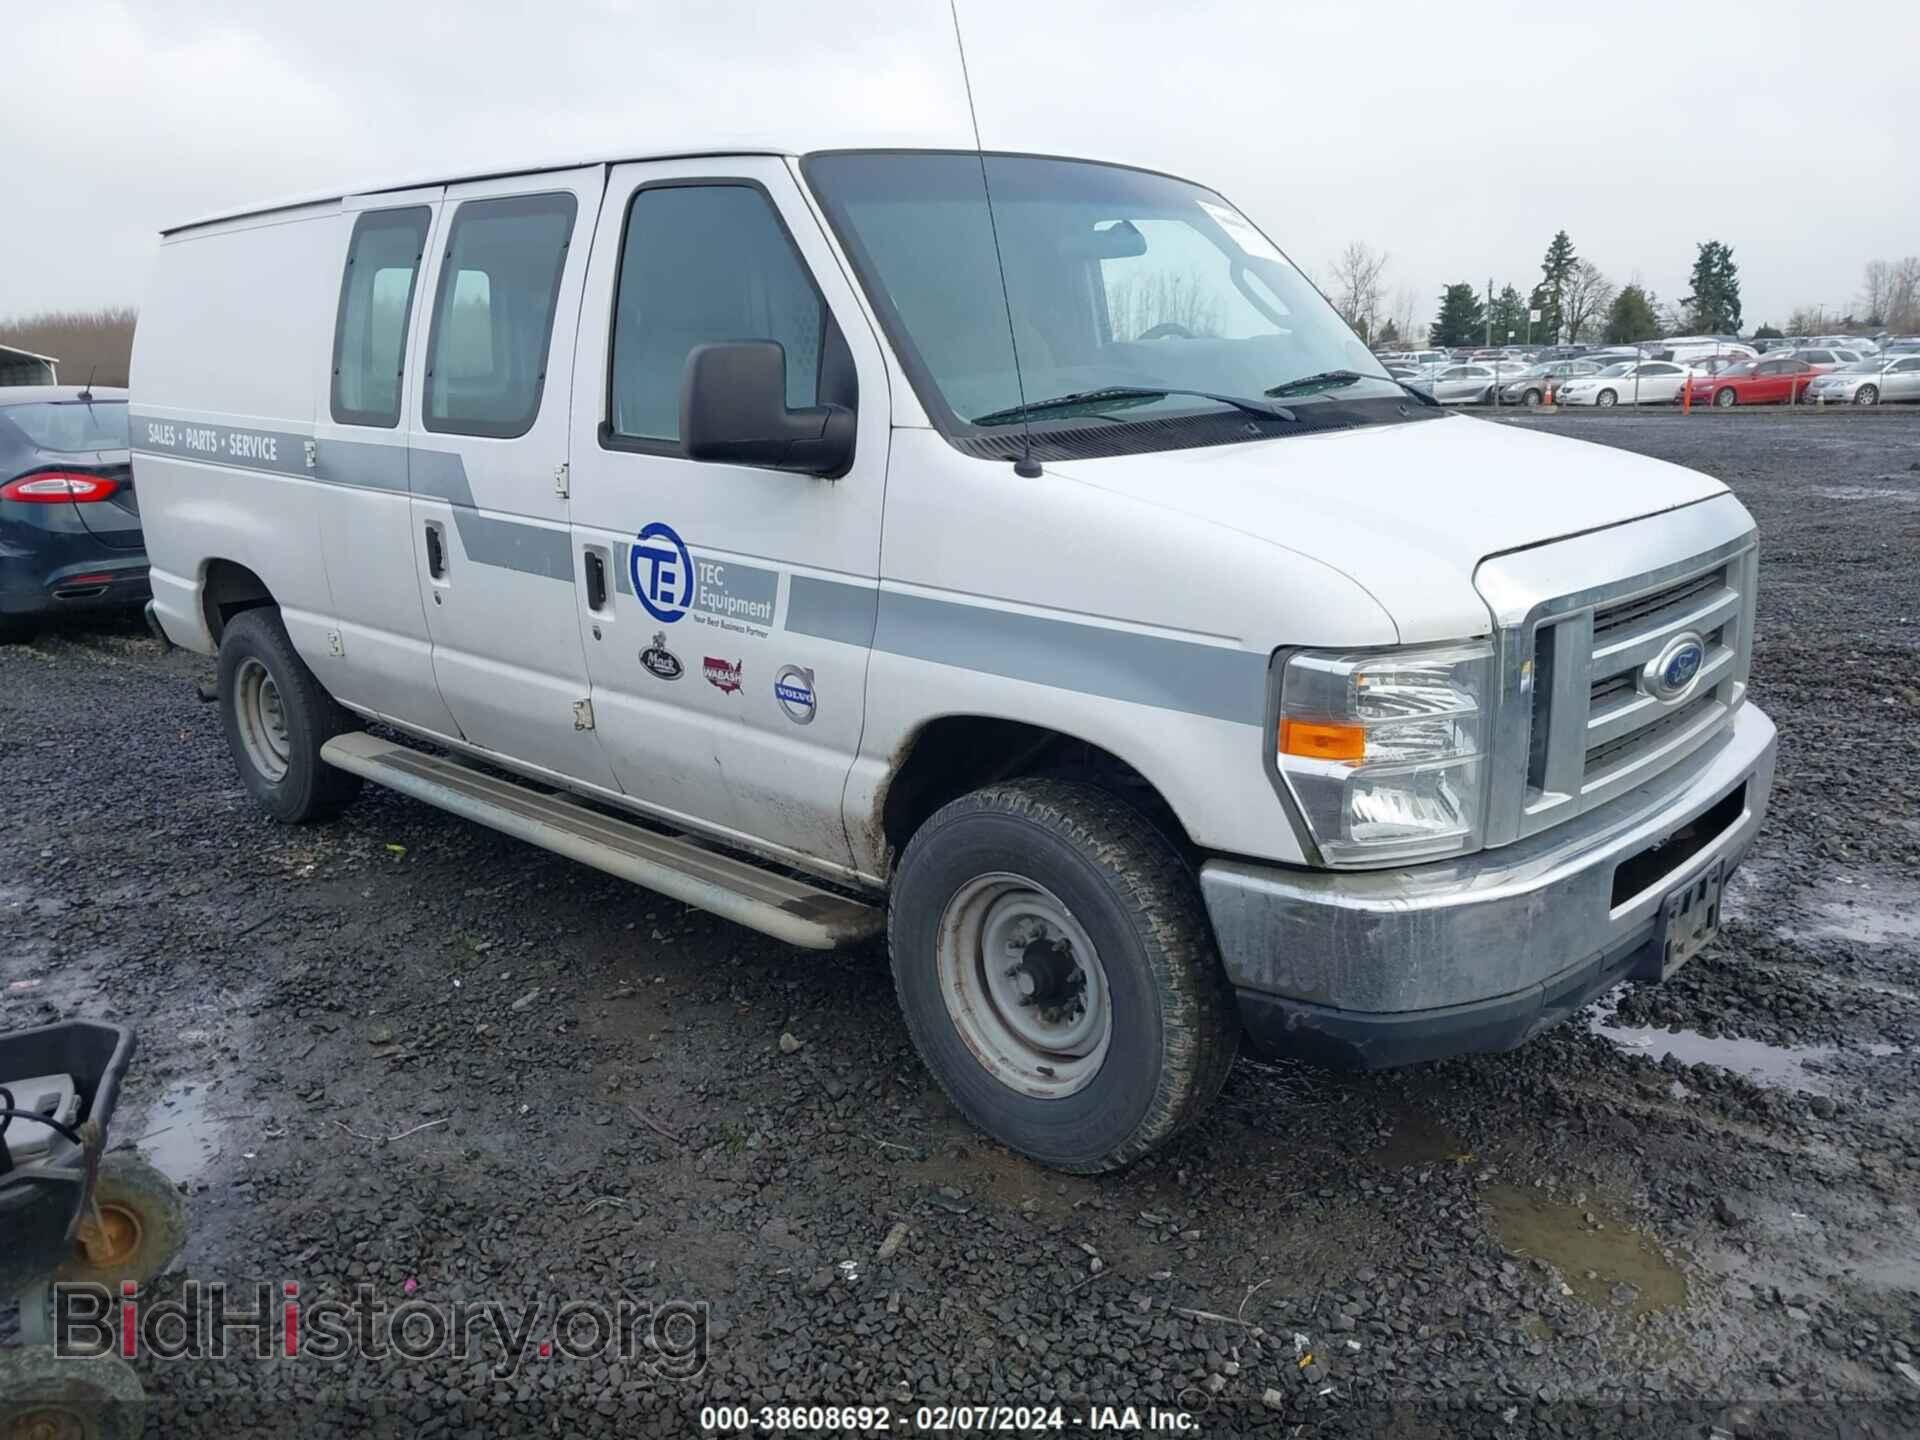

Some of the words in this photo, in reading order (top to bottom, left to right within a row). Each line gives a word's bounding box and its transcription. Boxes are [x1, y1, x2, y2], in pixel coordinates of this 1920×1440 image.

[148, 423, 176, 447] SALES
[185, 428, 217, 453] PARTS
[229, 433, 278, 461] SERVICE
[699, 562, 724, 586] TEC
[700, 585, 772, 619] Equipment
[704, 668, 742, 683] WABASH
[777, 687, 813, 702] VOLVO
